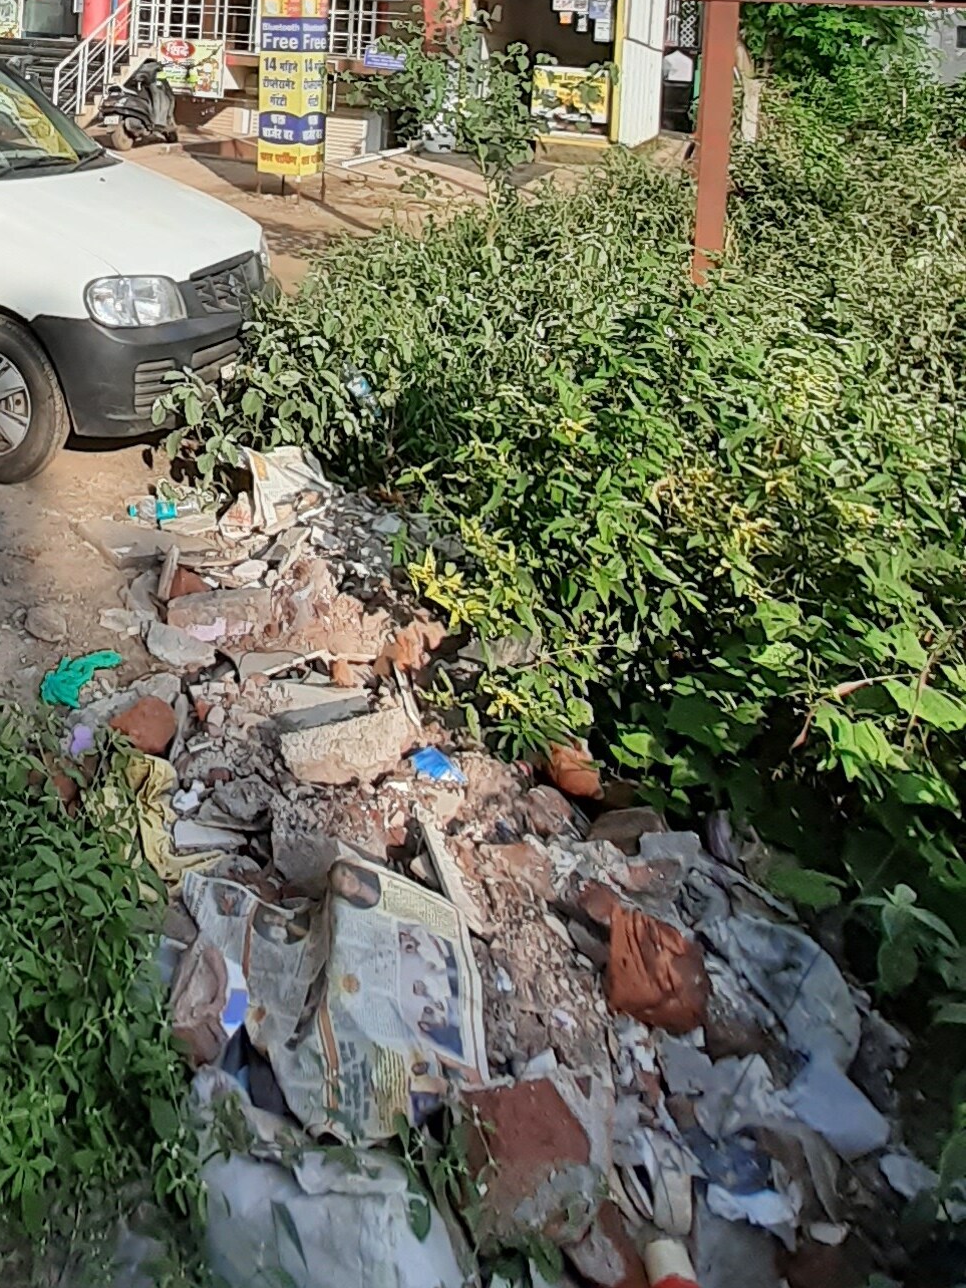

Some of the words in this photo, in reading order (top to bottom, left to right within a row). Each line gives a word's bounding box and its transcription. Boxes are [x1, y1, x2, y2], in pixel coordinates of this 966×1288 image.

[262, 32, 299, 49] Free
[302, 33, 327, 50] Free
[264, 56, 277, 71] 14
